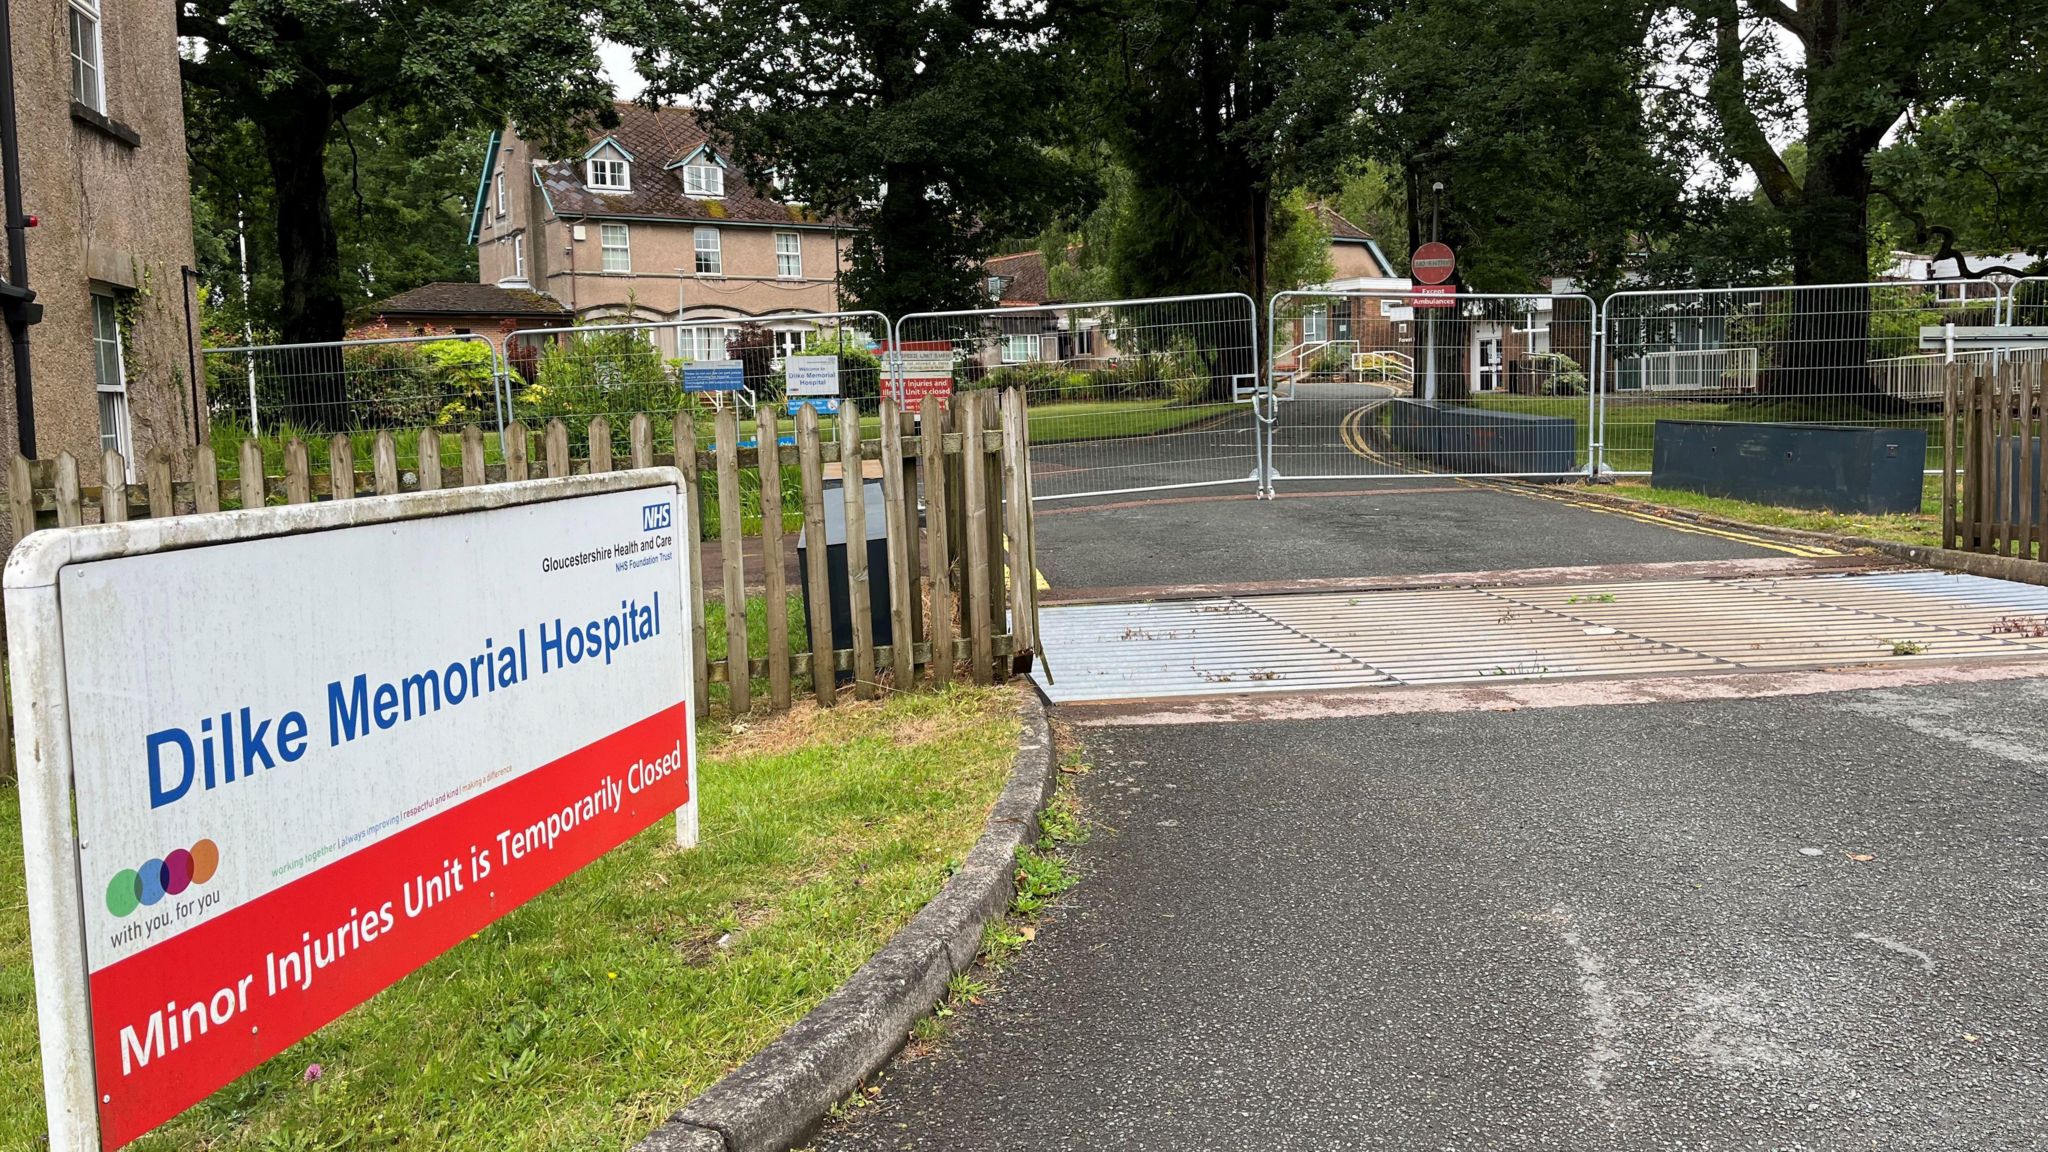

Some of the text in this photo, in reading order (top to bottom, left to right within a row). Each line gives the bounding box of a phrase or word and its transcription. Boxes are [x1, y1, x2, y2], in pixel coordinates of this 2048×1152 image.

[643, 503, 671, 531] NHS
[542, 536, 672, 573] Gloucestershire Health and Care
[616, 552, 672, 573] NHS Foundation Trust
[145, 591, 661, 810] Dilke Memorial Hospital
[271, 856, 304, 878] working
[304, 842, 336, 863] together
[341, 830, 366, 847] always
[366, 815, 400, 835] improving
[403, 798, 434, 820] respectful
[435, 791, 446, 805] and
[446, 787, 459, 799] kind
[462, 778, 482, 792] making
[486, 764, 512, 780] difference
[110, 890, 220, 948] with you, for you
[119, 739, 681, 1077] Minor Injuries Unit is Temporarily Closed
